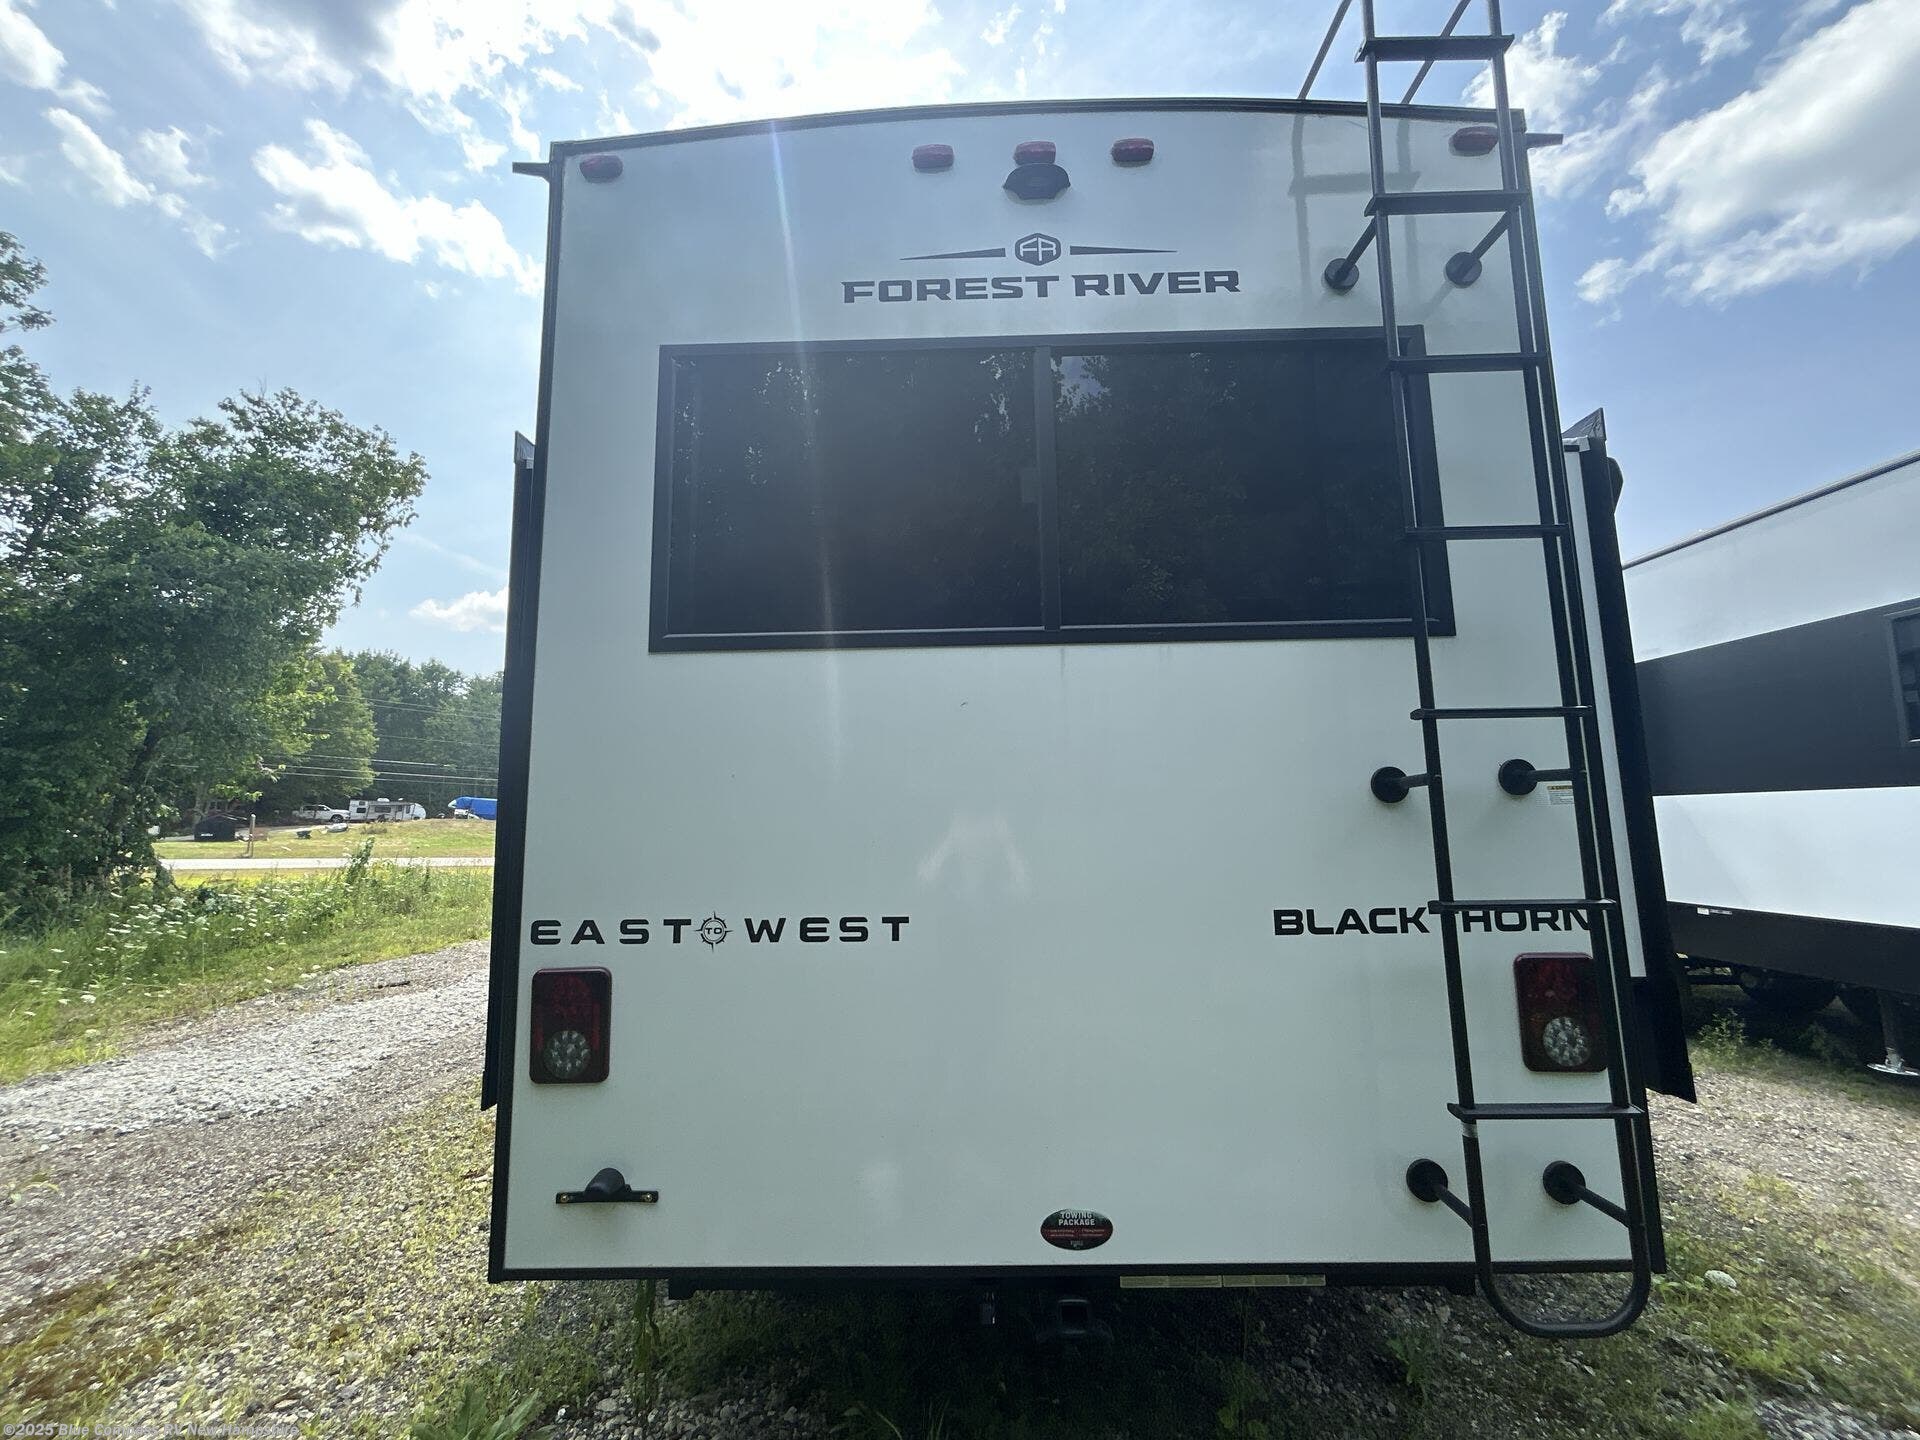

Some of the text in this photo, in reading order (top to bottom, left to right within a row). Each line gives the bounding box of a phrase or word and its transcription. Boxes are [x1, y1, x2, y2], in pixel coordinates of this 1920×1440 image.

[841, 270, 1241, 303] FOREST RIVER
[530, 916, 909, 945] EAST TO WEST
[1273, 907, 1590, 935] BLACKHORN
[1060, 1211, 1093, 1219] TOWING
